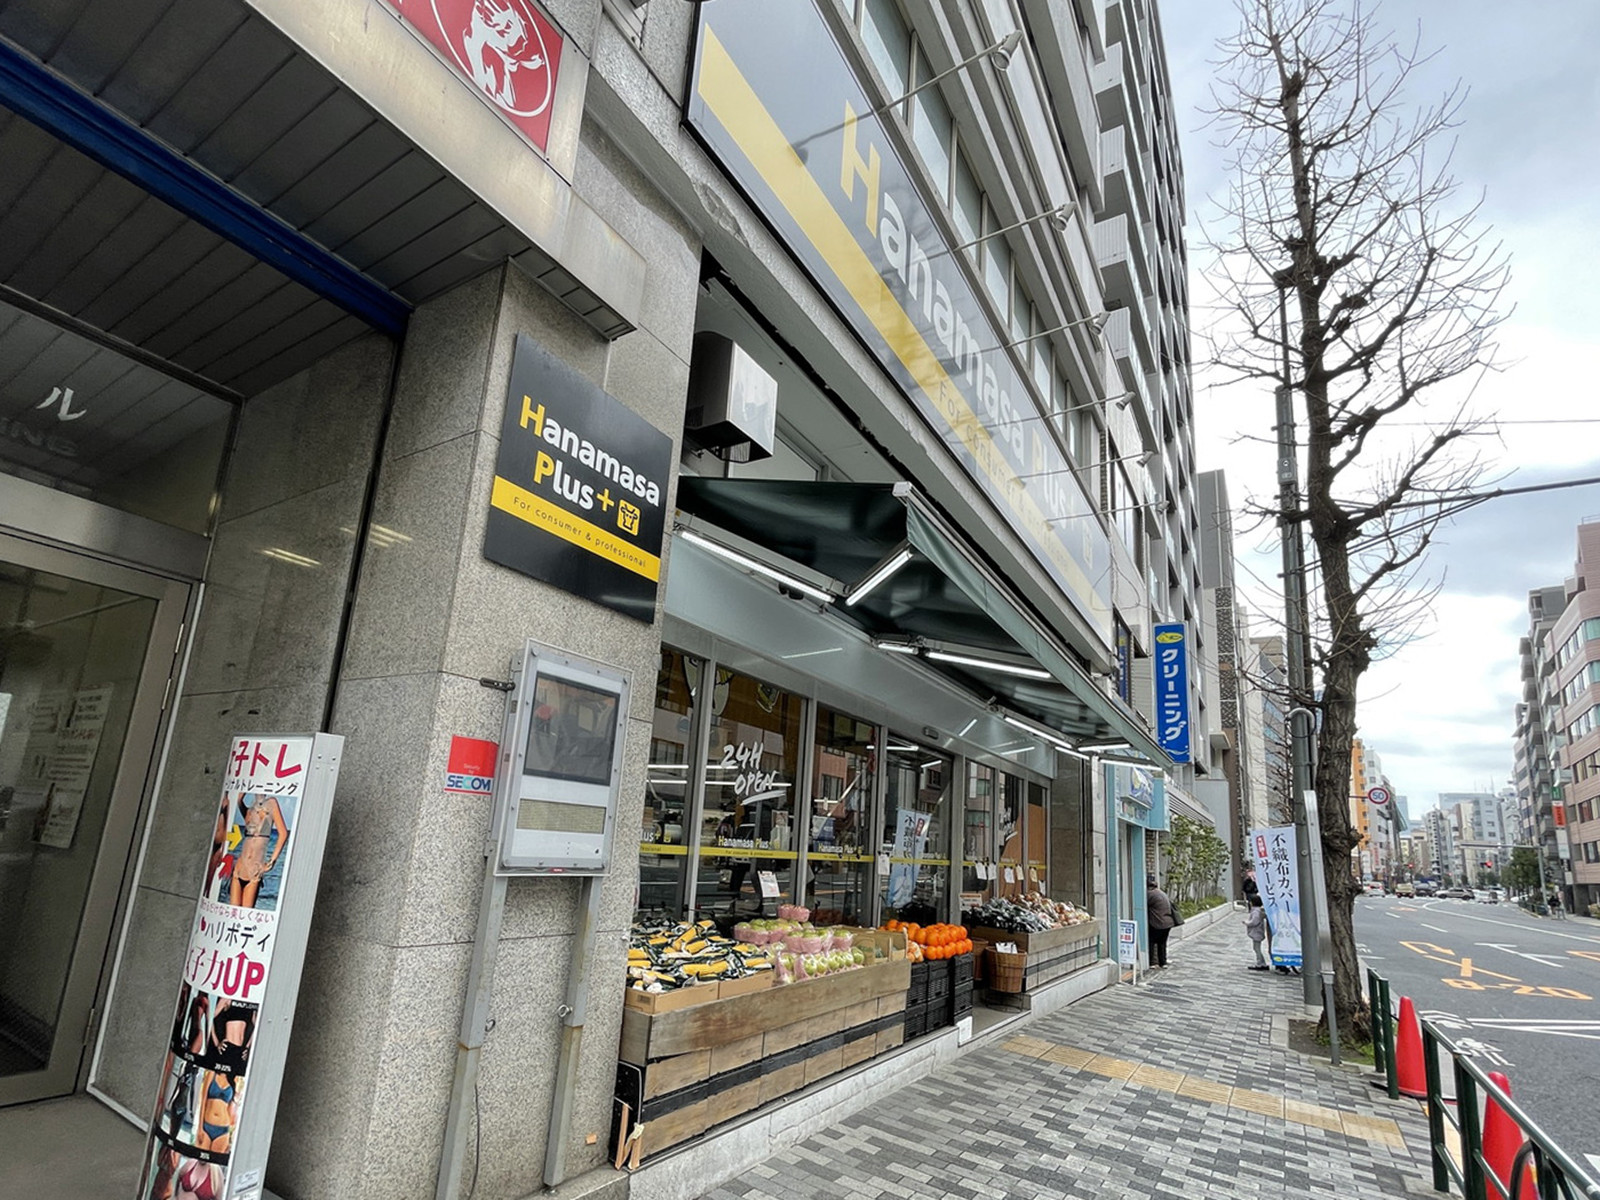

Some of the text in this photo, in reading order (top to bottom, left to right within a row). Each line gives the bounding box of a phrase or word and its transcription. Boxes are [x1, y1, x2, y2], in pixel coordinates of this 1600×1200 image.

[840, 99, 1025, 468] Hanamasa
[35, 386, 88, 422] ル
[939, 380, 961, 424] For
[519, 394, 661, 508] Hanamasa
[513, 496, 647, 568] For consumer & professional
[1161, 648, 1187, 742] クリーニング
[721, 741, 764, 769] 24H
[447, 774, 491, 792] SECOM
[733, 770, 781, 796] OPEN
[1371, 791, 1385, 801] 50
[718, 836, 754, 848] Hanamasa
[1258, 859, 1278, 908] サービス
[1271, 832, 1294, 914] 不織布カバー
[1440, 978, 1594, 1001] 8-20
